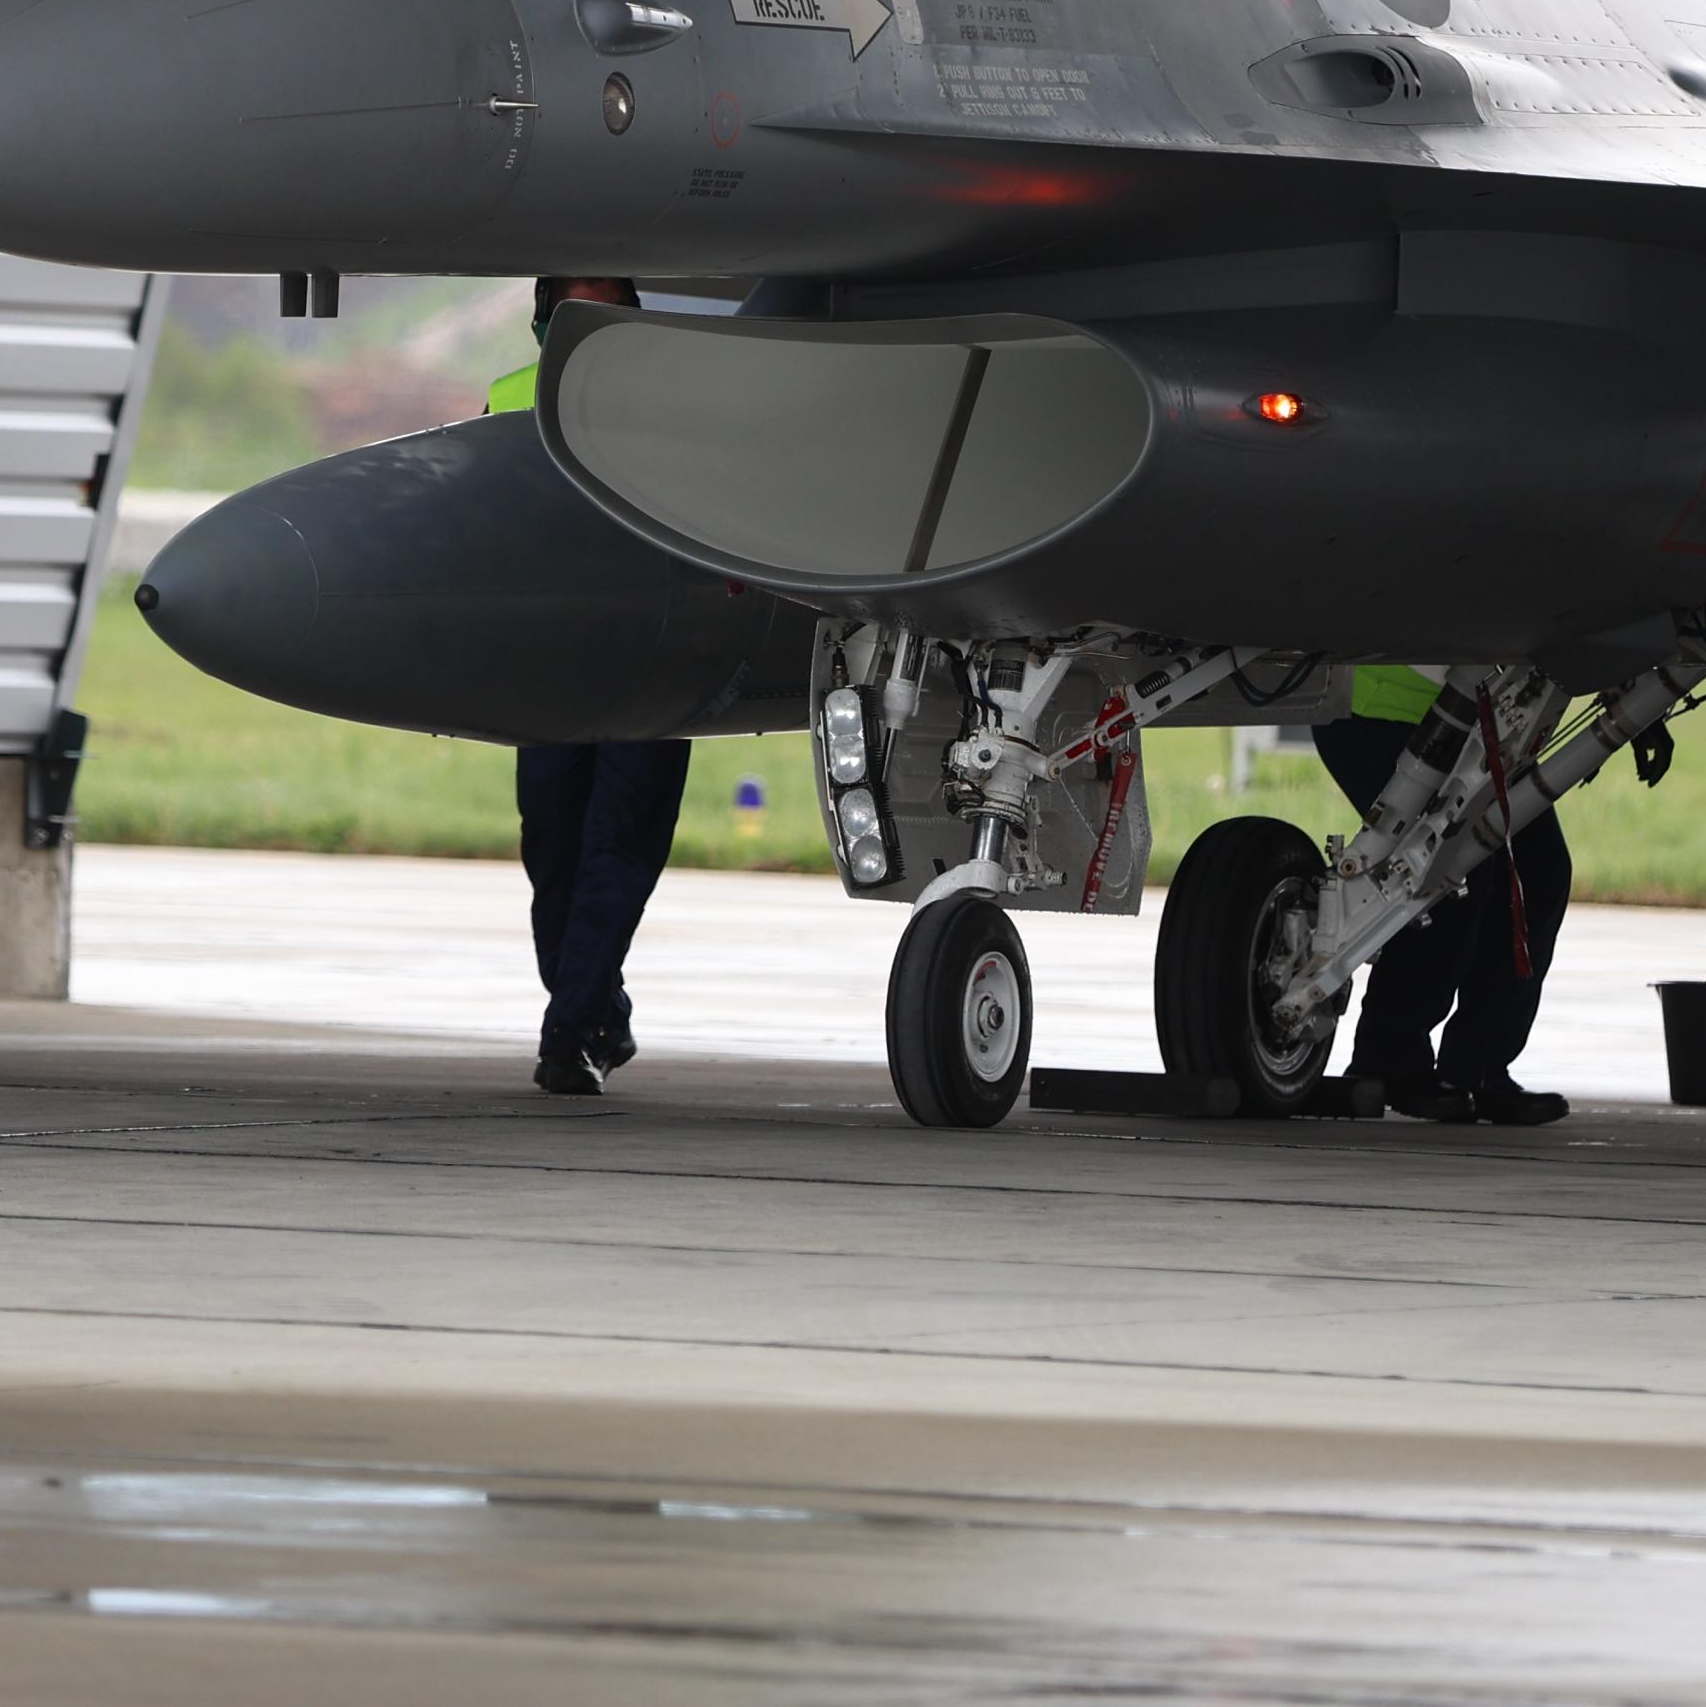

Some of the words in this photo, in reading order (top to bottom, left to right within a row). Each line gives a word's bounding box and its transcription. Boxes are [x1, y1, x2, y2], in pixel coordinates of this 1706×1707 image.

[1009, 7, 1032, 23] FUEL
[960, 25, 979, 40] PER
[509, 39, 525, 94] PAINT
[943, 65, 971, 80] PUSH
[973, 66, 1013, 82] BUTTON
[1015, 68, 1030, 82] TO
[1032, 69, 1059, 83] OPEN
[1061, 70, 1091, 84] DOOR
[951, 84, 978, 99] PULL
[980, 85, 1005, 100] RING
[1007, 86, 1029, 100] OUT
[1042, 86, 1069, 101] FEET
[1070, 88, 1087, 102] TO
[961, 102, 1012, 117] JETTISON
[1012, 103, 1058, 118] CANOPY
[504, 147, 518, 169] DO
